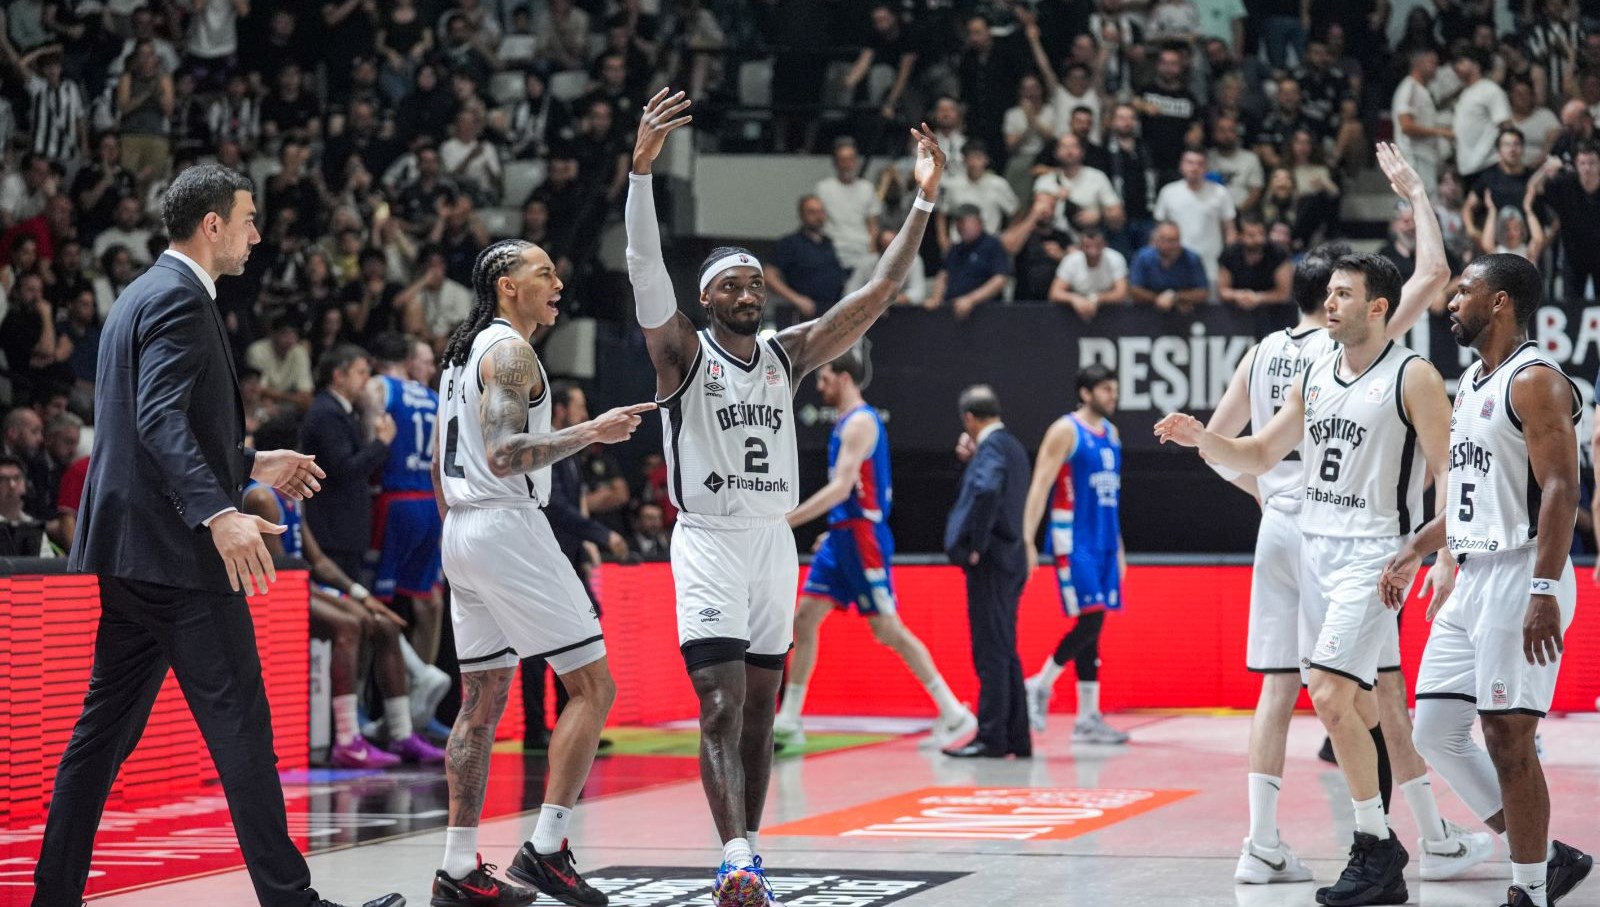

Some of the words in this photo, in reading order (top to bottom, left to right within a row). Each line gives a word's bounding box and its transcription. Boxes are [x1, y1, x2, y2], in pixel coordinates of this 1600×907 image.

[716, 401, 783, 435] BEŞİKTAŞ
[744, 437, 769, 473] 2
[1320, 447, 1342, 482] 6
[1459, 483, 1475, 522] 5
